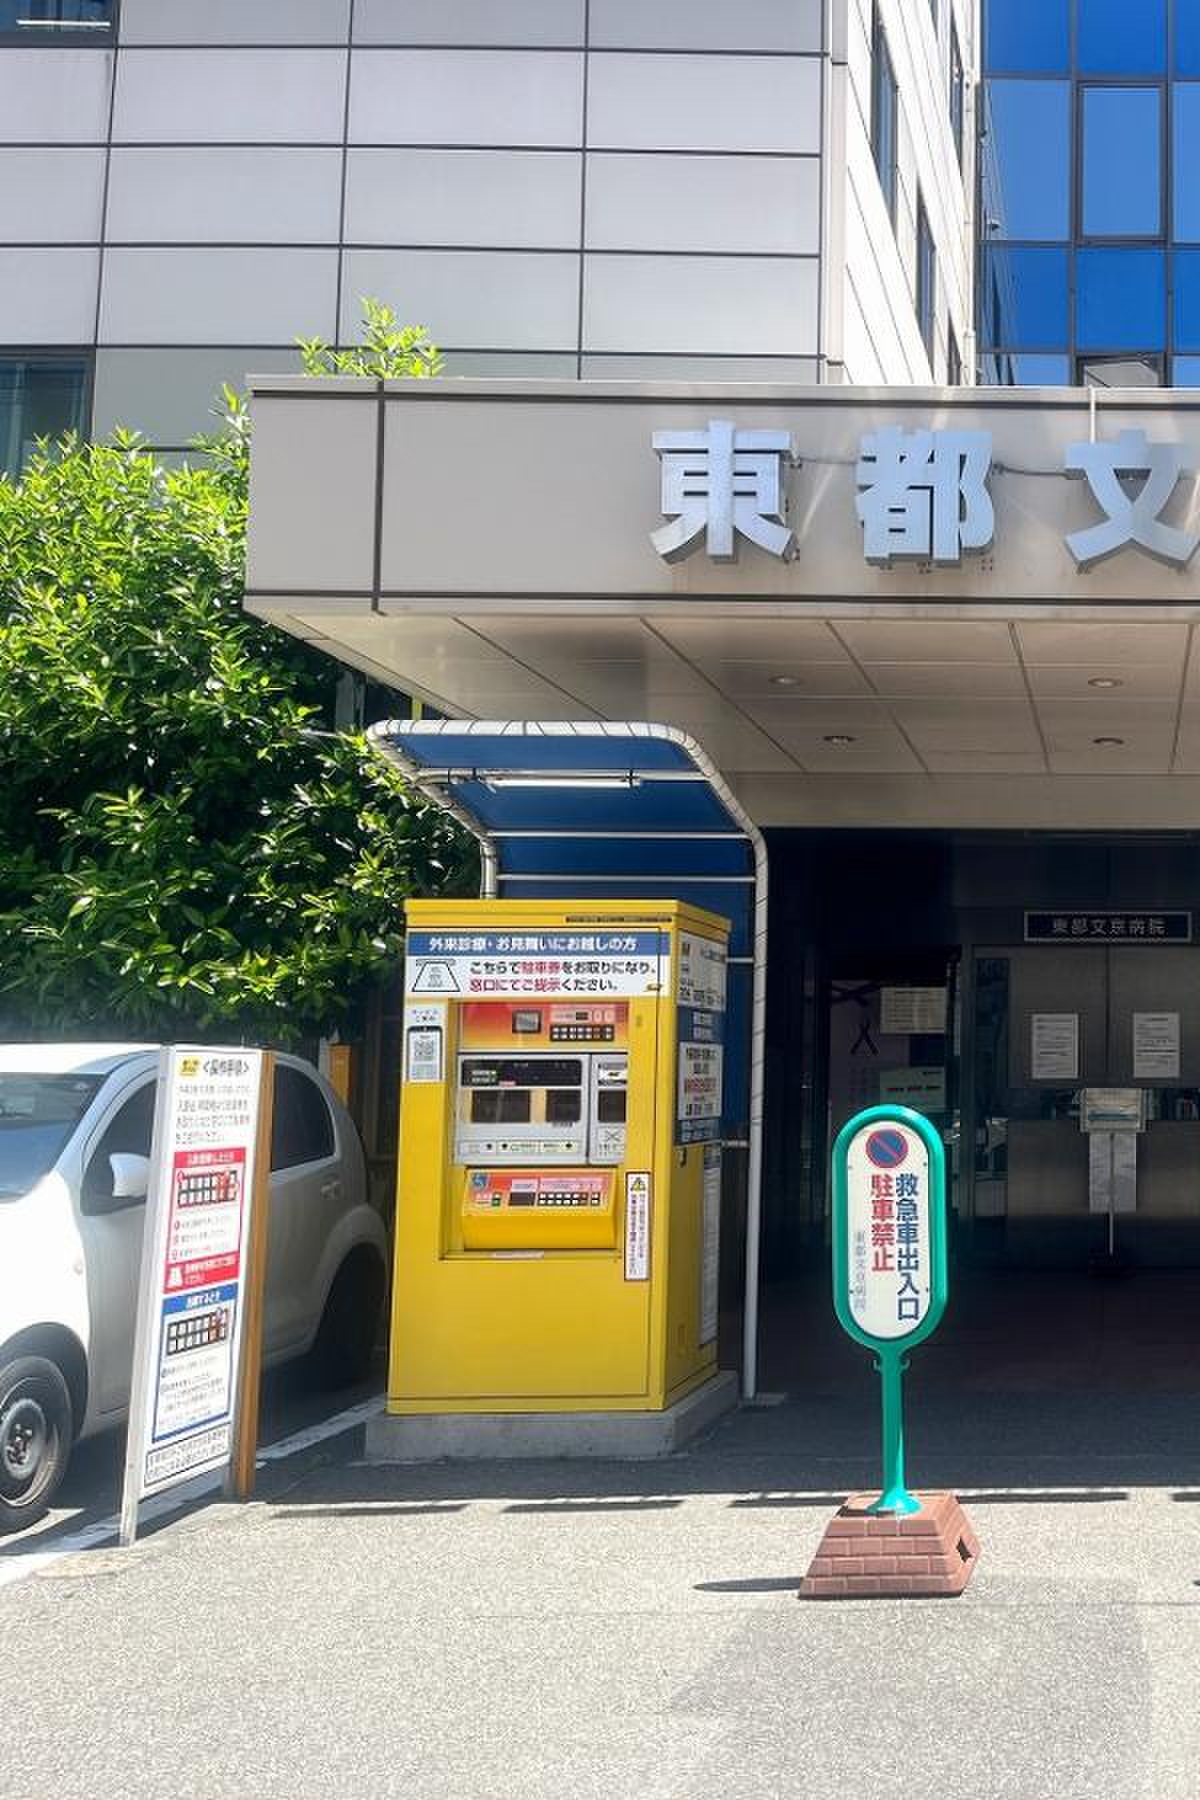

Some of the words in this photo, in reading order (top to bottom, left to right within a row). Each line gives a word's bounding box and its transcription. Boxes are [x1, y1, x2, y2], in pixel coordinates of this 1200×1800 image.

[1051, 917, 1166, 935] 東都文京病院
[871, 1173, 895, 1272] 駐車禁止
[895, 1173, 919, 1321] 救急車出入口
